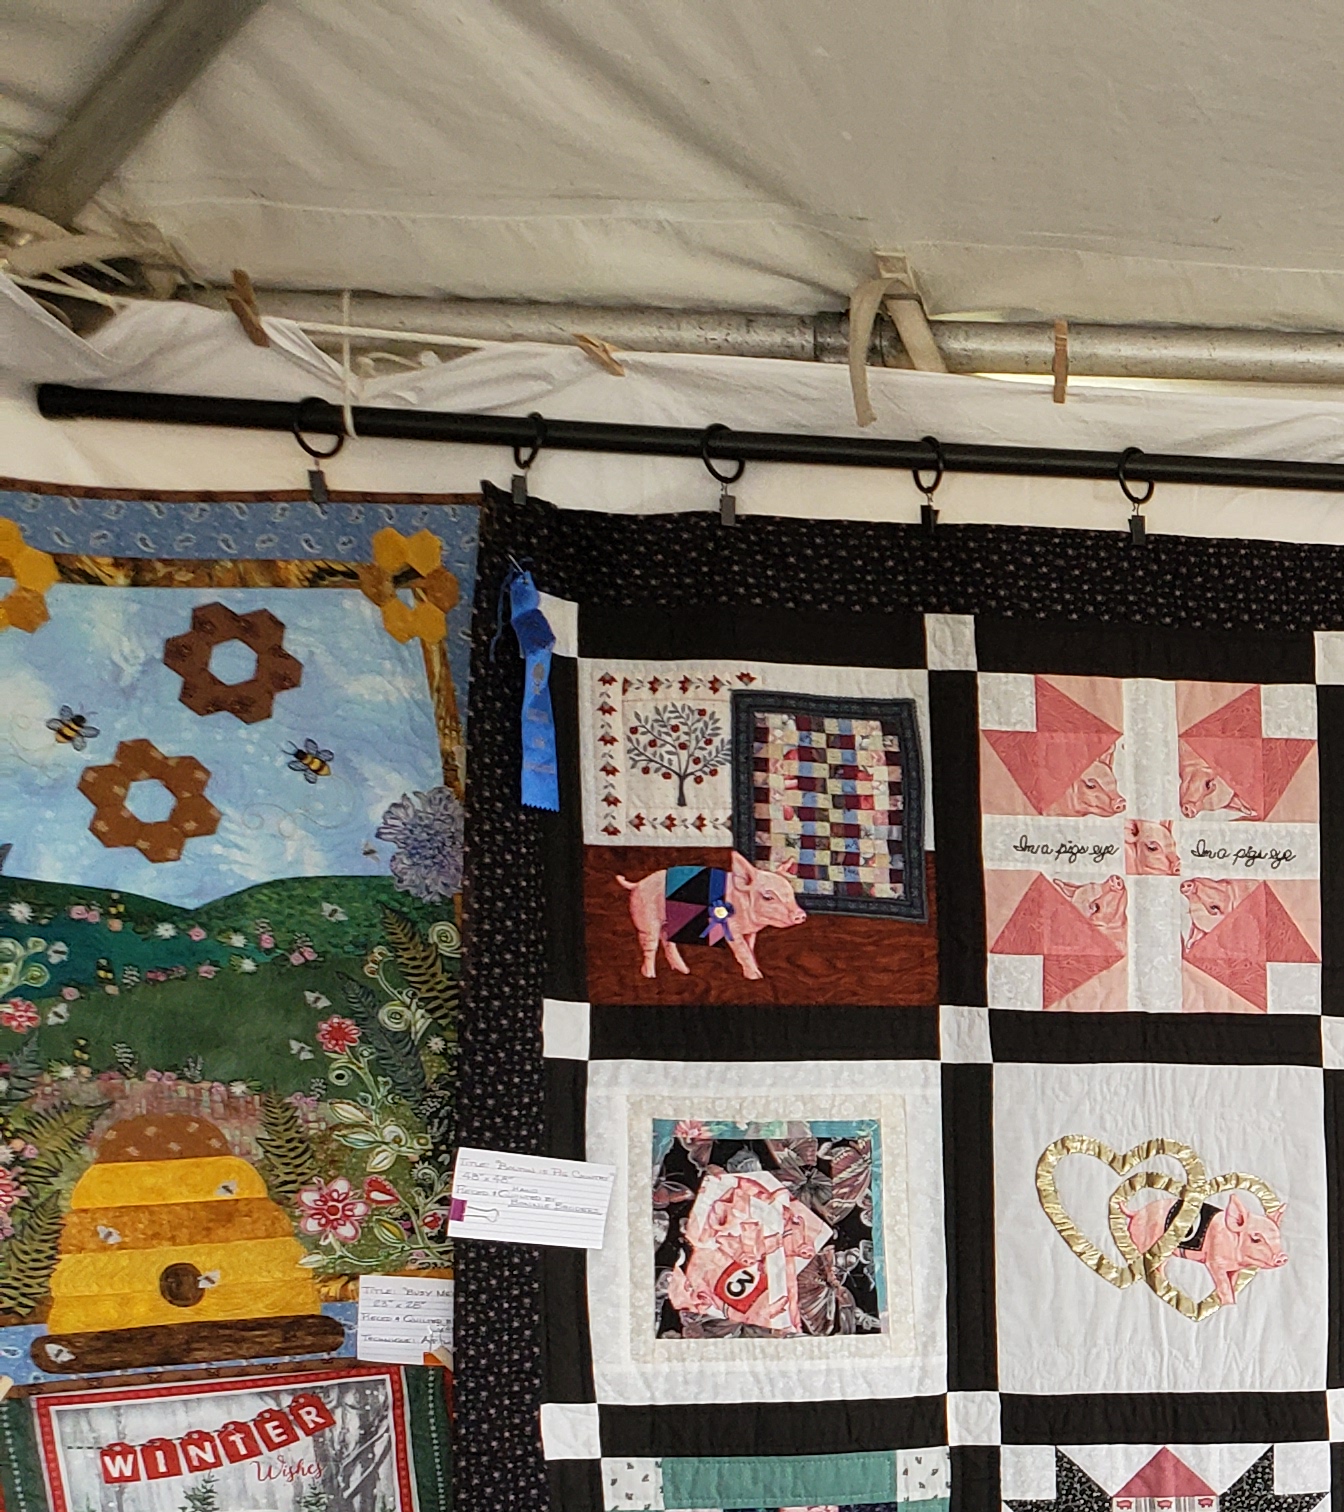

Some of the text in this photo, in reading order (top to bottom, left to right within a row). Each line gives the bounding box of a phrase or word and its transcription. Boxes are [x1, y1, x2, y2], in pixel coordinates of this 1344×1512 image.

[1054, 840, 1090, 864] pigs
[1091, 844, 1120, 864] eye
[1232, 846, 1267, 868] pigs
[1268, 849, 1297, 869] eye
[726, 1269, 756, 1298] 3
[103, 1404, 328, 1480] WINTER
[250, 1453, 327, 1484] Wishes
